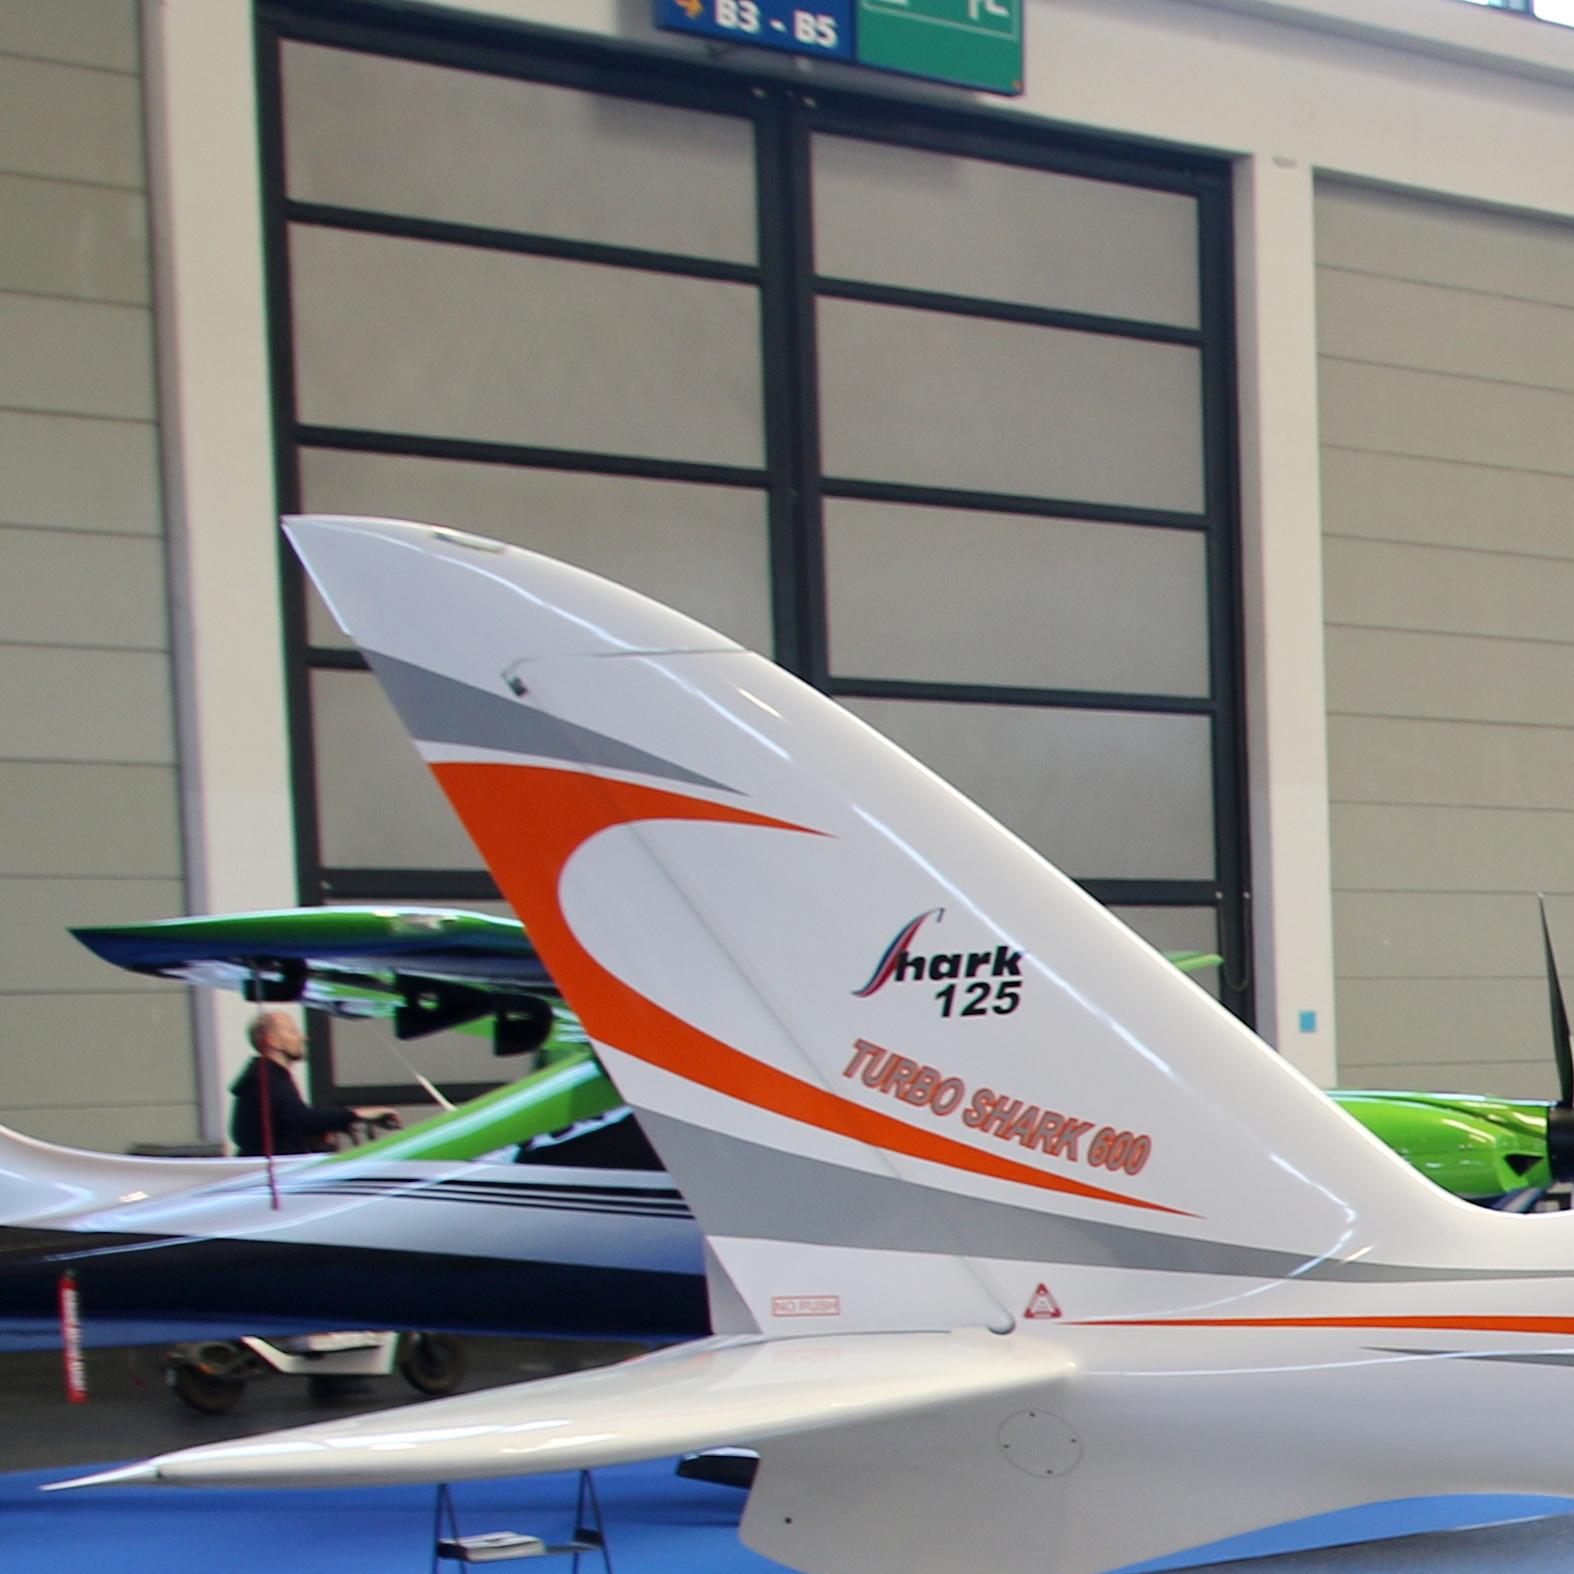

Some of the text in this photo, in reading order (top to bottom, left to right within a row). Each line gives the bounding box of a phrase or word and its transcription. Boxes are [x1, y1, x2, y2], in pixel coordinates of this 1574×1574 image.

[715, 0, 760, 34] B3
[794, 10, 838, 48] B5
[851, 907, 1023, 998] Shark
[935, 981, 1022, 1018] 125
[842, 1037, 1152, 1176] TURBO SHARK 600
